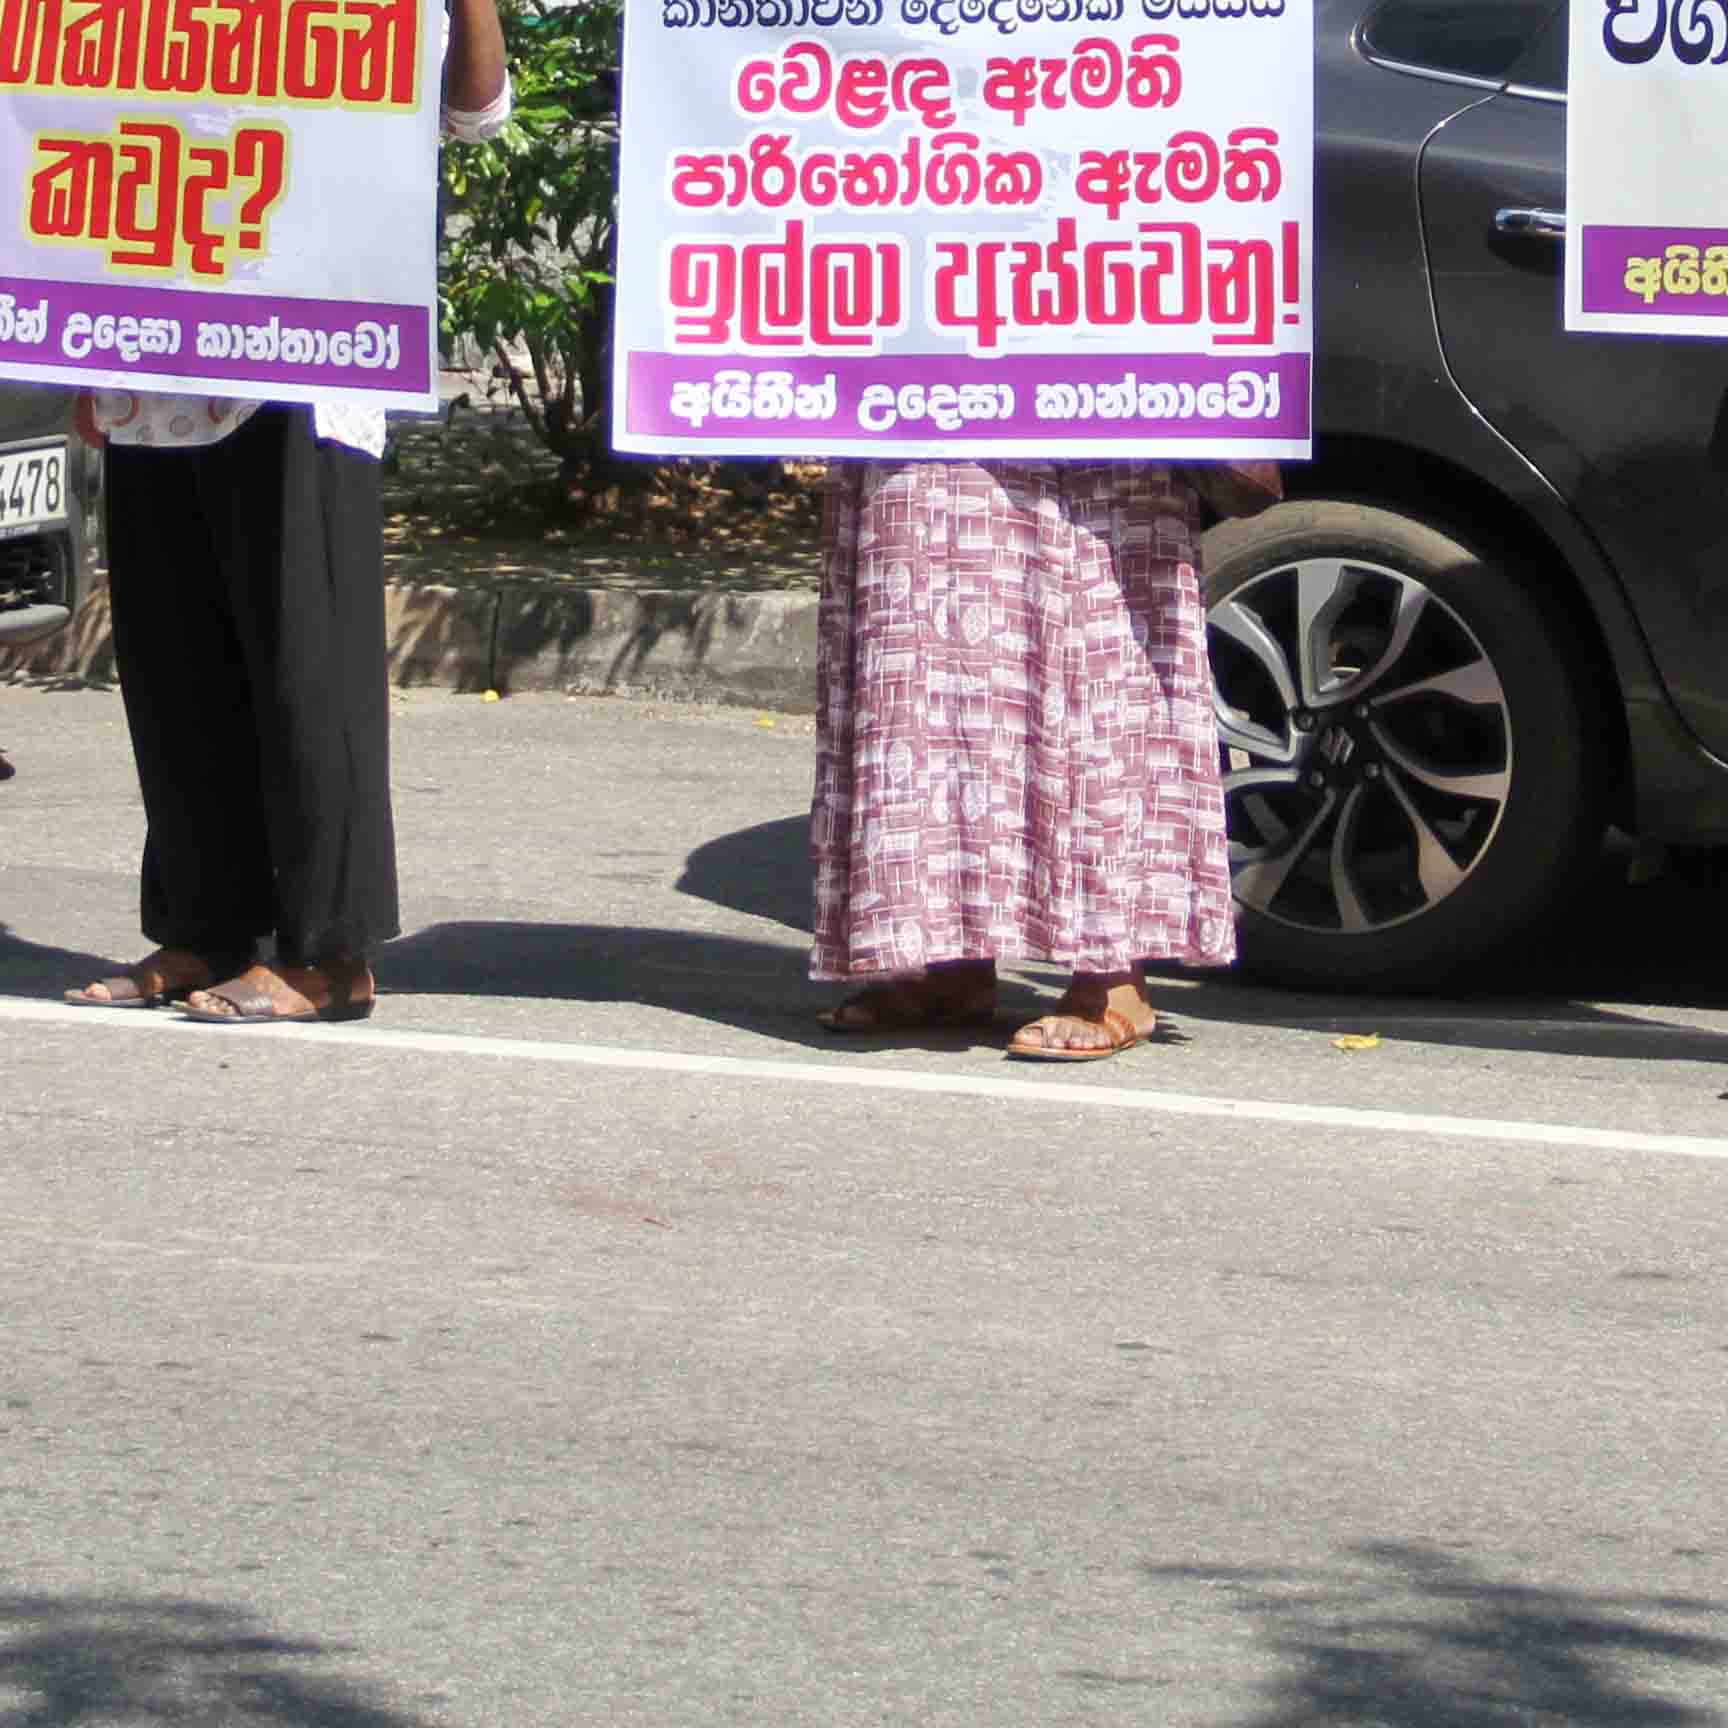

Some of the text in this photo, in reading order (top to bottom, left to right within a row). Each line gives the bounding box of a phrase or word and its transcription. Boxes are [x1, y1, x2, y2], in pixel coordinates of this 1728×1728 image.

[737, 32, 1184, 129] වෙළඳ ඇමති
[30, 122, 284, 274] කවුද?
[672, 128, 1283, 221] පාරිභෝගික ඇමති
[669, 217, 1300, 347] ඉල්ලා අස්වෙනු!
[62, 312, 181, 363] උදෙසා
[197, 317, 400, 371] කාන්තාවෝ
[859, 381, 1014, 427] උදෙසා
[1036, 374, 1280, 421] කාන්තාවෝ
